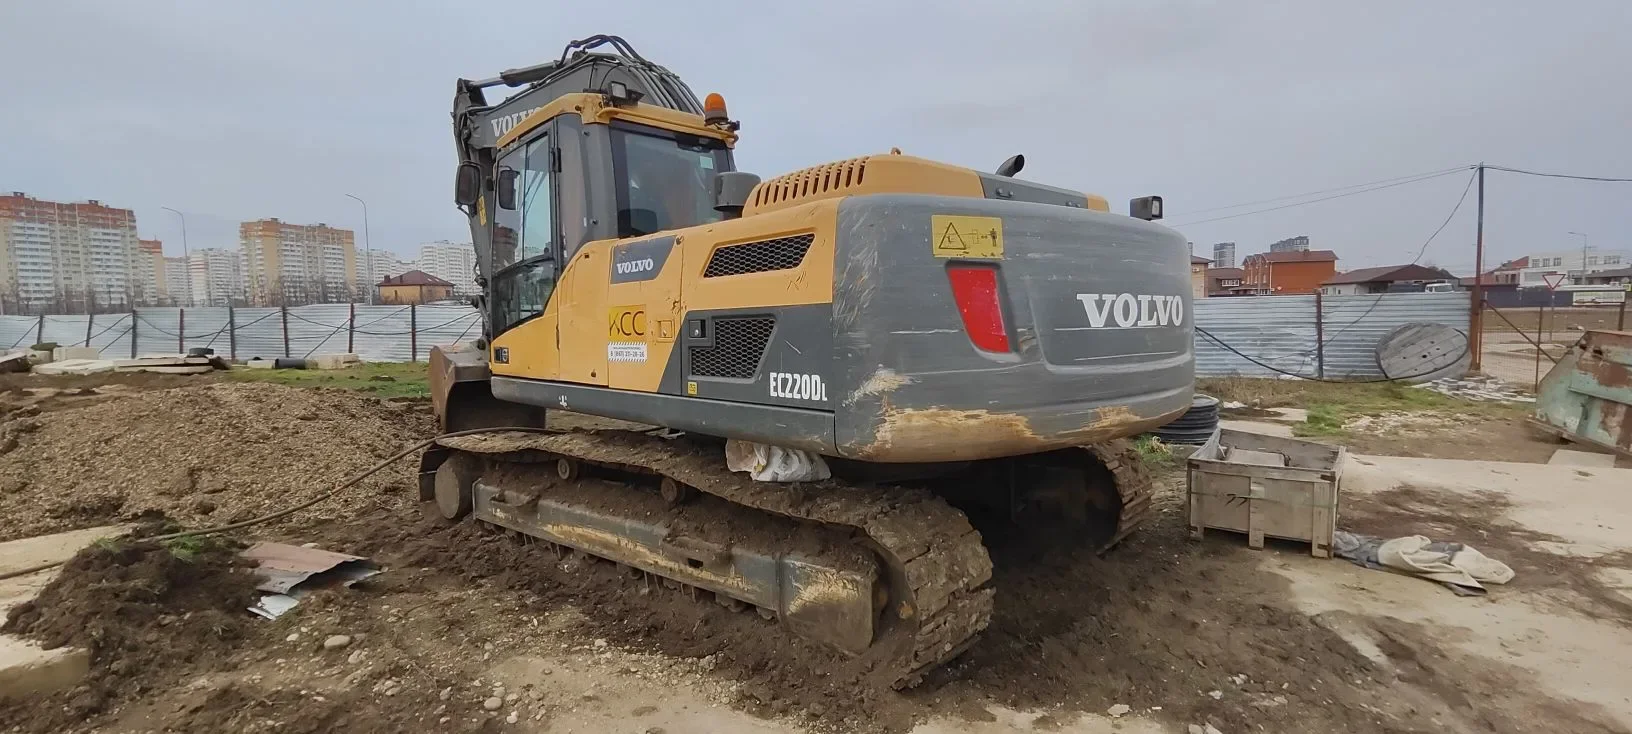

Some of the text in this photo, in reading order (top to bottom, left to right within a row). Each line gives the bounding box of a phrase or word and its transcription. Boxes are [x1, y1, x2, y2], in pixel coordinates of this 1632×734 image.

[491, 107, 541, 137] VOL
[616, 258, 654, 274] VOLVO
[1076, 292, 1184, 328] VOLVO
